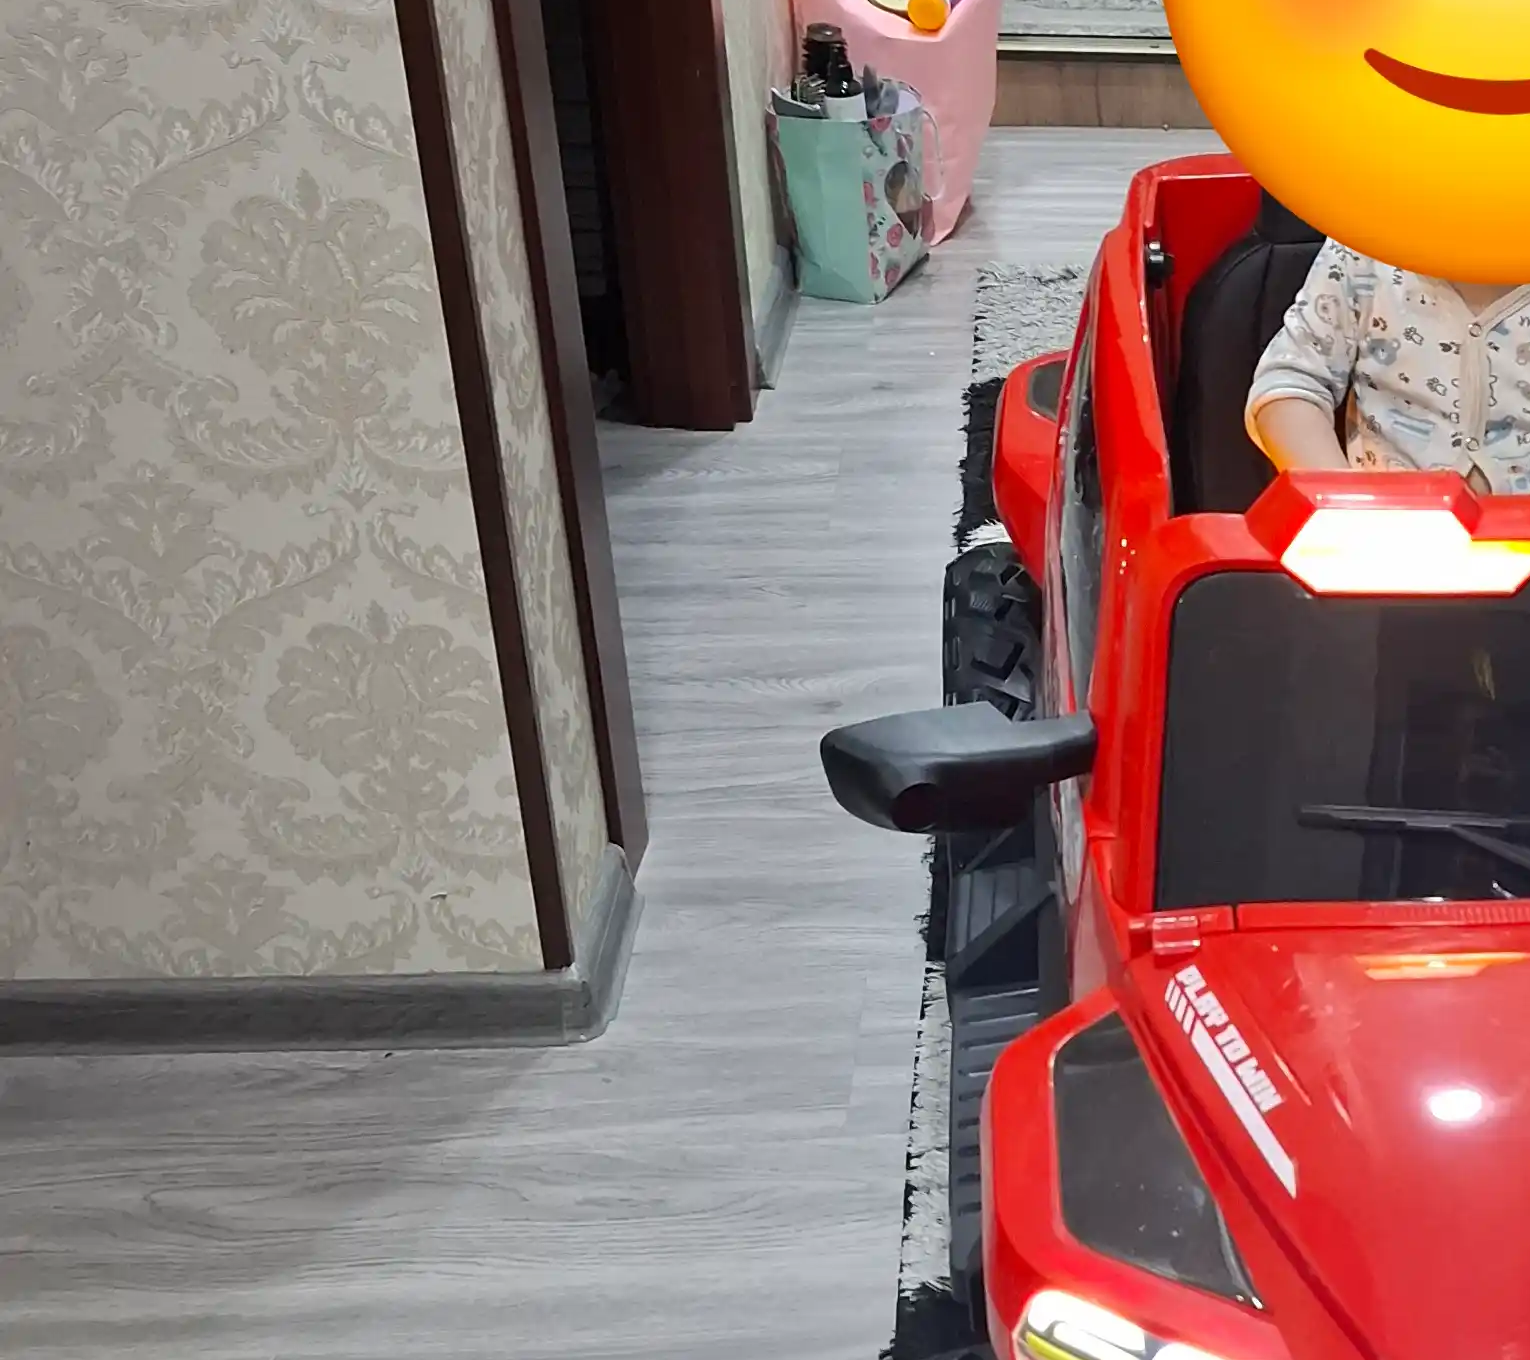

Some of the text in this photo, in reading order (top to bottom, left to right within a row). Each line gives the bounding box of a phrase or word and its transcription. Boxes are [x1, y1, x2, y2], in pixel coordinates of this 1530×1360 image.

[1175, 964, 1283, 1113] PLAY TO WIN
